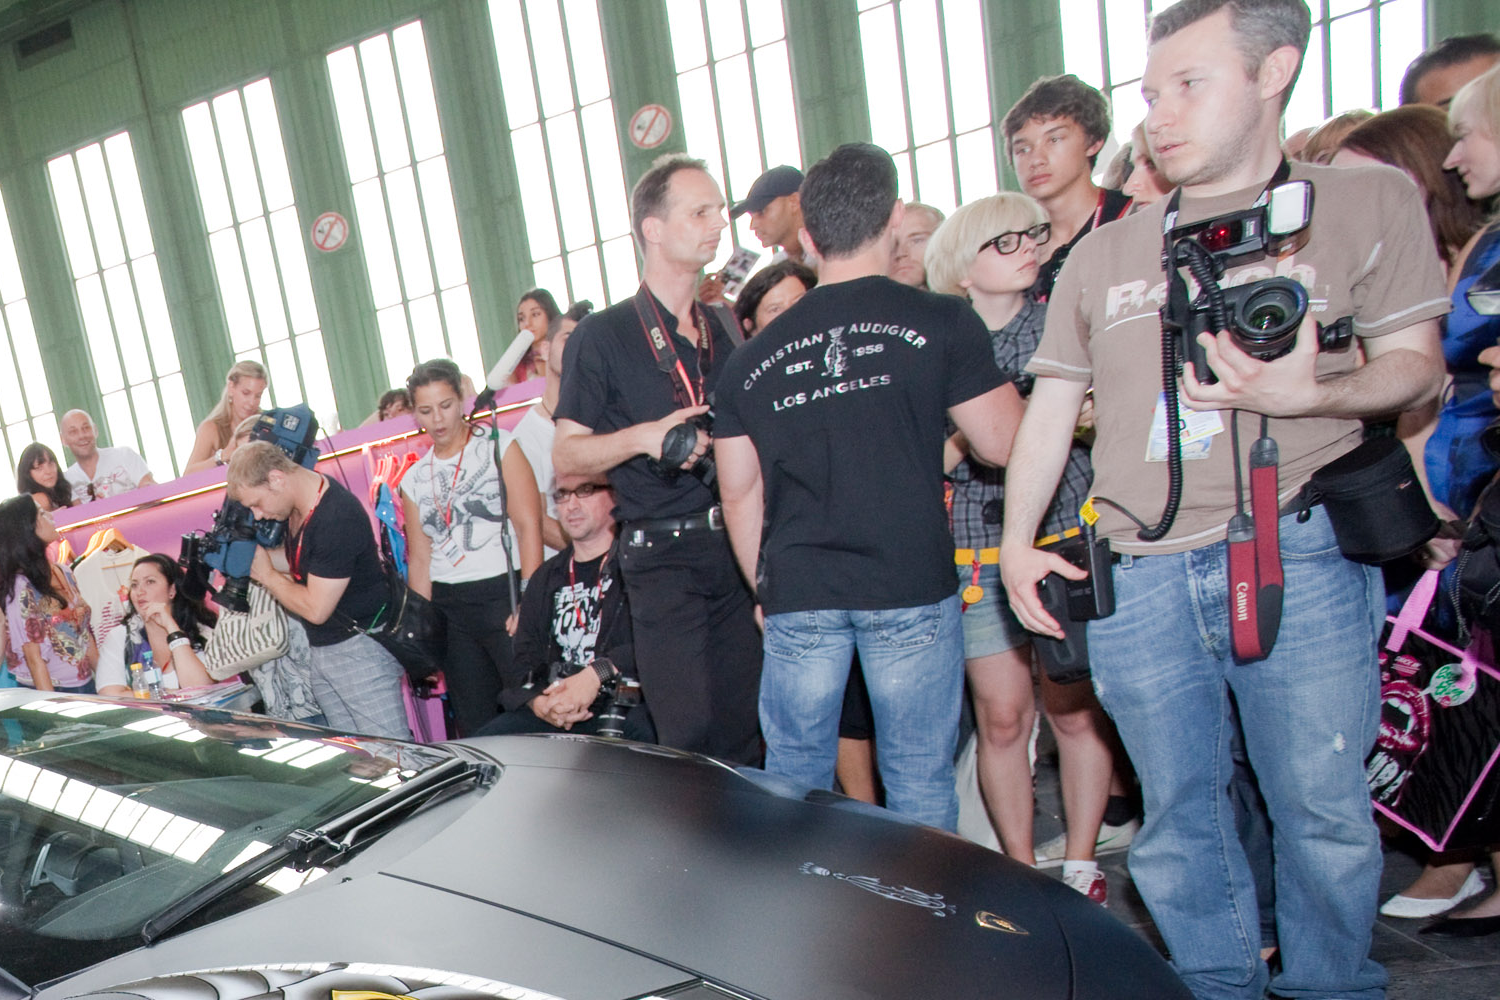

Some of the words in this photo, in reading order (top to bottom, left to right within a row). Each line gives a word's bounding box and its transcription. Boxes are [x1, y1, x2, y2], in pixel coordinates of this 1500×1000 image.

[650, 327, 666, 350] EOS
[743, 333, 824, 391] CHRISTIAN
[848, 322, 927, 349] AUDIGIER
[785, 360, 815, 375] EST.
[852, 343, 885, 357] 1958
[773, 392, 807, 411] LOS
[811, 374, 891, 400] ANGELES
[1235, 581, 1249, 621] Canon
